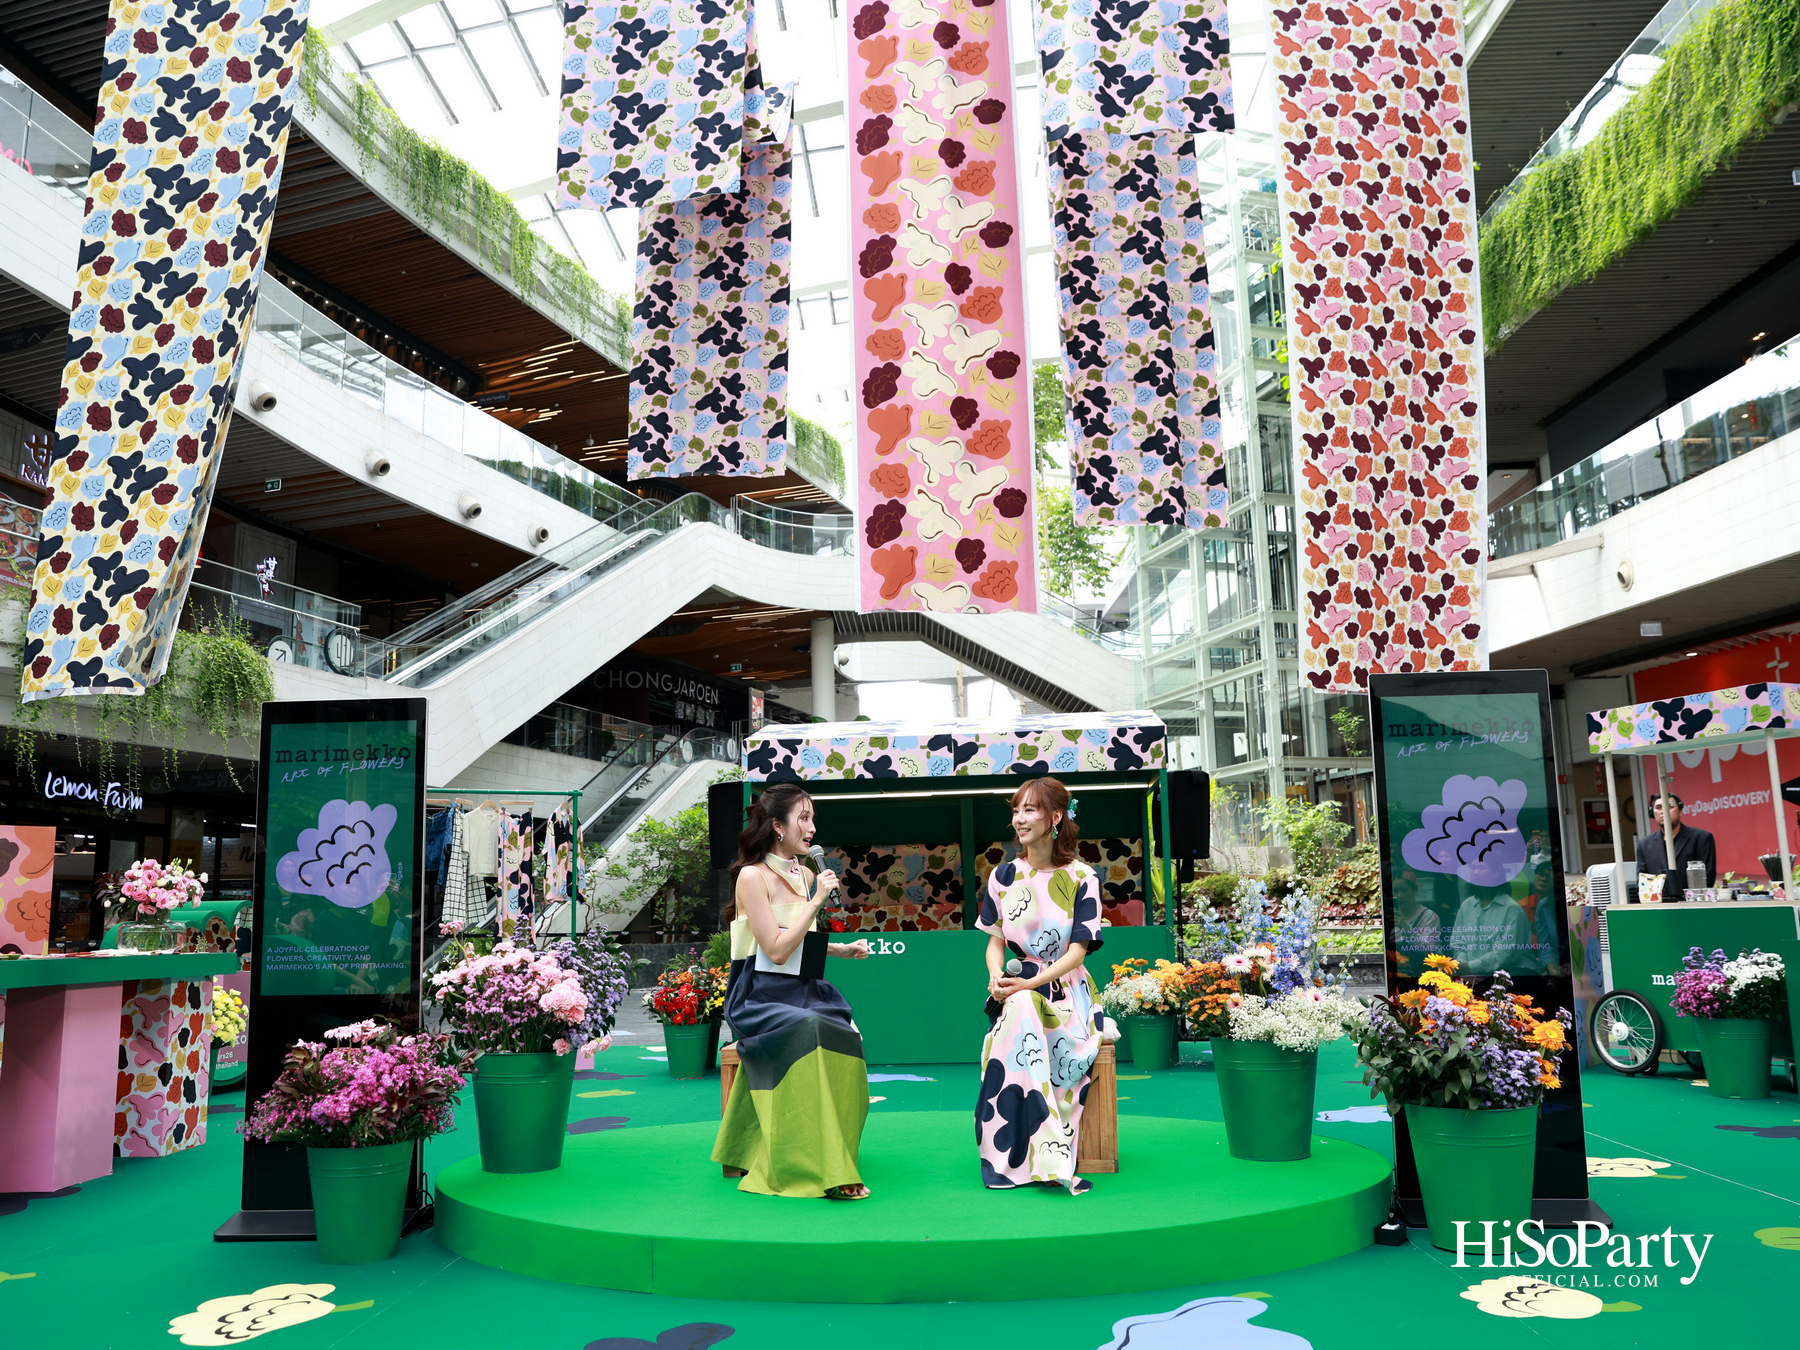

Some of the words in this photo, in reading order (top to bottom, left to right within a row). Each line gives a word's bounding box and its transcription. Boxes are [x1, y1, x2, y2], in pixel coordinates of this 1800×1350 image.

[593, 670, 719, 705] CHONGJAROEN
[1388, 717, 1536, 738] marimekko
[275, 744, 411, 763] marimekko
[1397, 742, 1427, 758] ART
[1435, 740, 1453, 752] OF
[1459, 731, 1529, 749] FLOWERS
[281, 768, 310, 783] ART
[317, 766, 334, 777] OF
[339, 756, 404, 775] FLOWERS
[44, 771, 99, 803] Lemon
[104, 782, 143, 810] Farm
[1682, 790, 1771, 816] eryDayDISCOVERY
[1407, 926, 1440, 934] JOYFUL
[1441, 925, 1498, 933] CELEBRATION
[305, 945, 358, 953] CELEBRATION
[307, 954, 353, 962] CREATIVITY,
[266, 963, 321, 971] MARIMEKKO'S
[350, 962, 407, 970] PRINTMAKING.
[1651, 974, 1676, 986] ma
